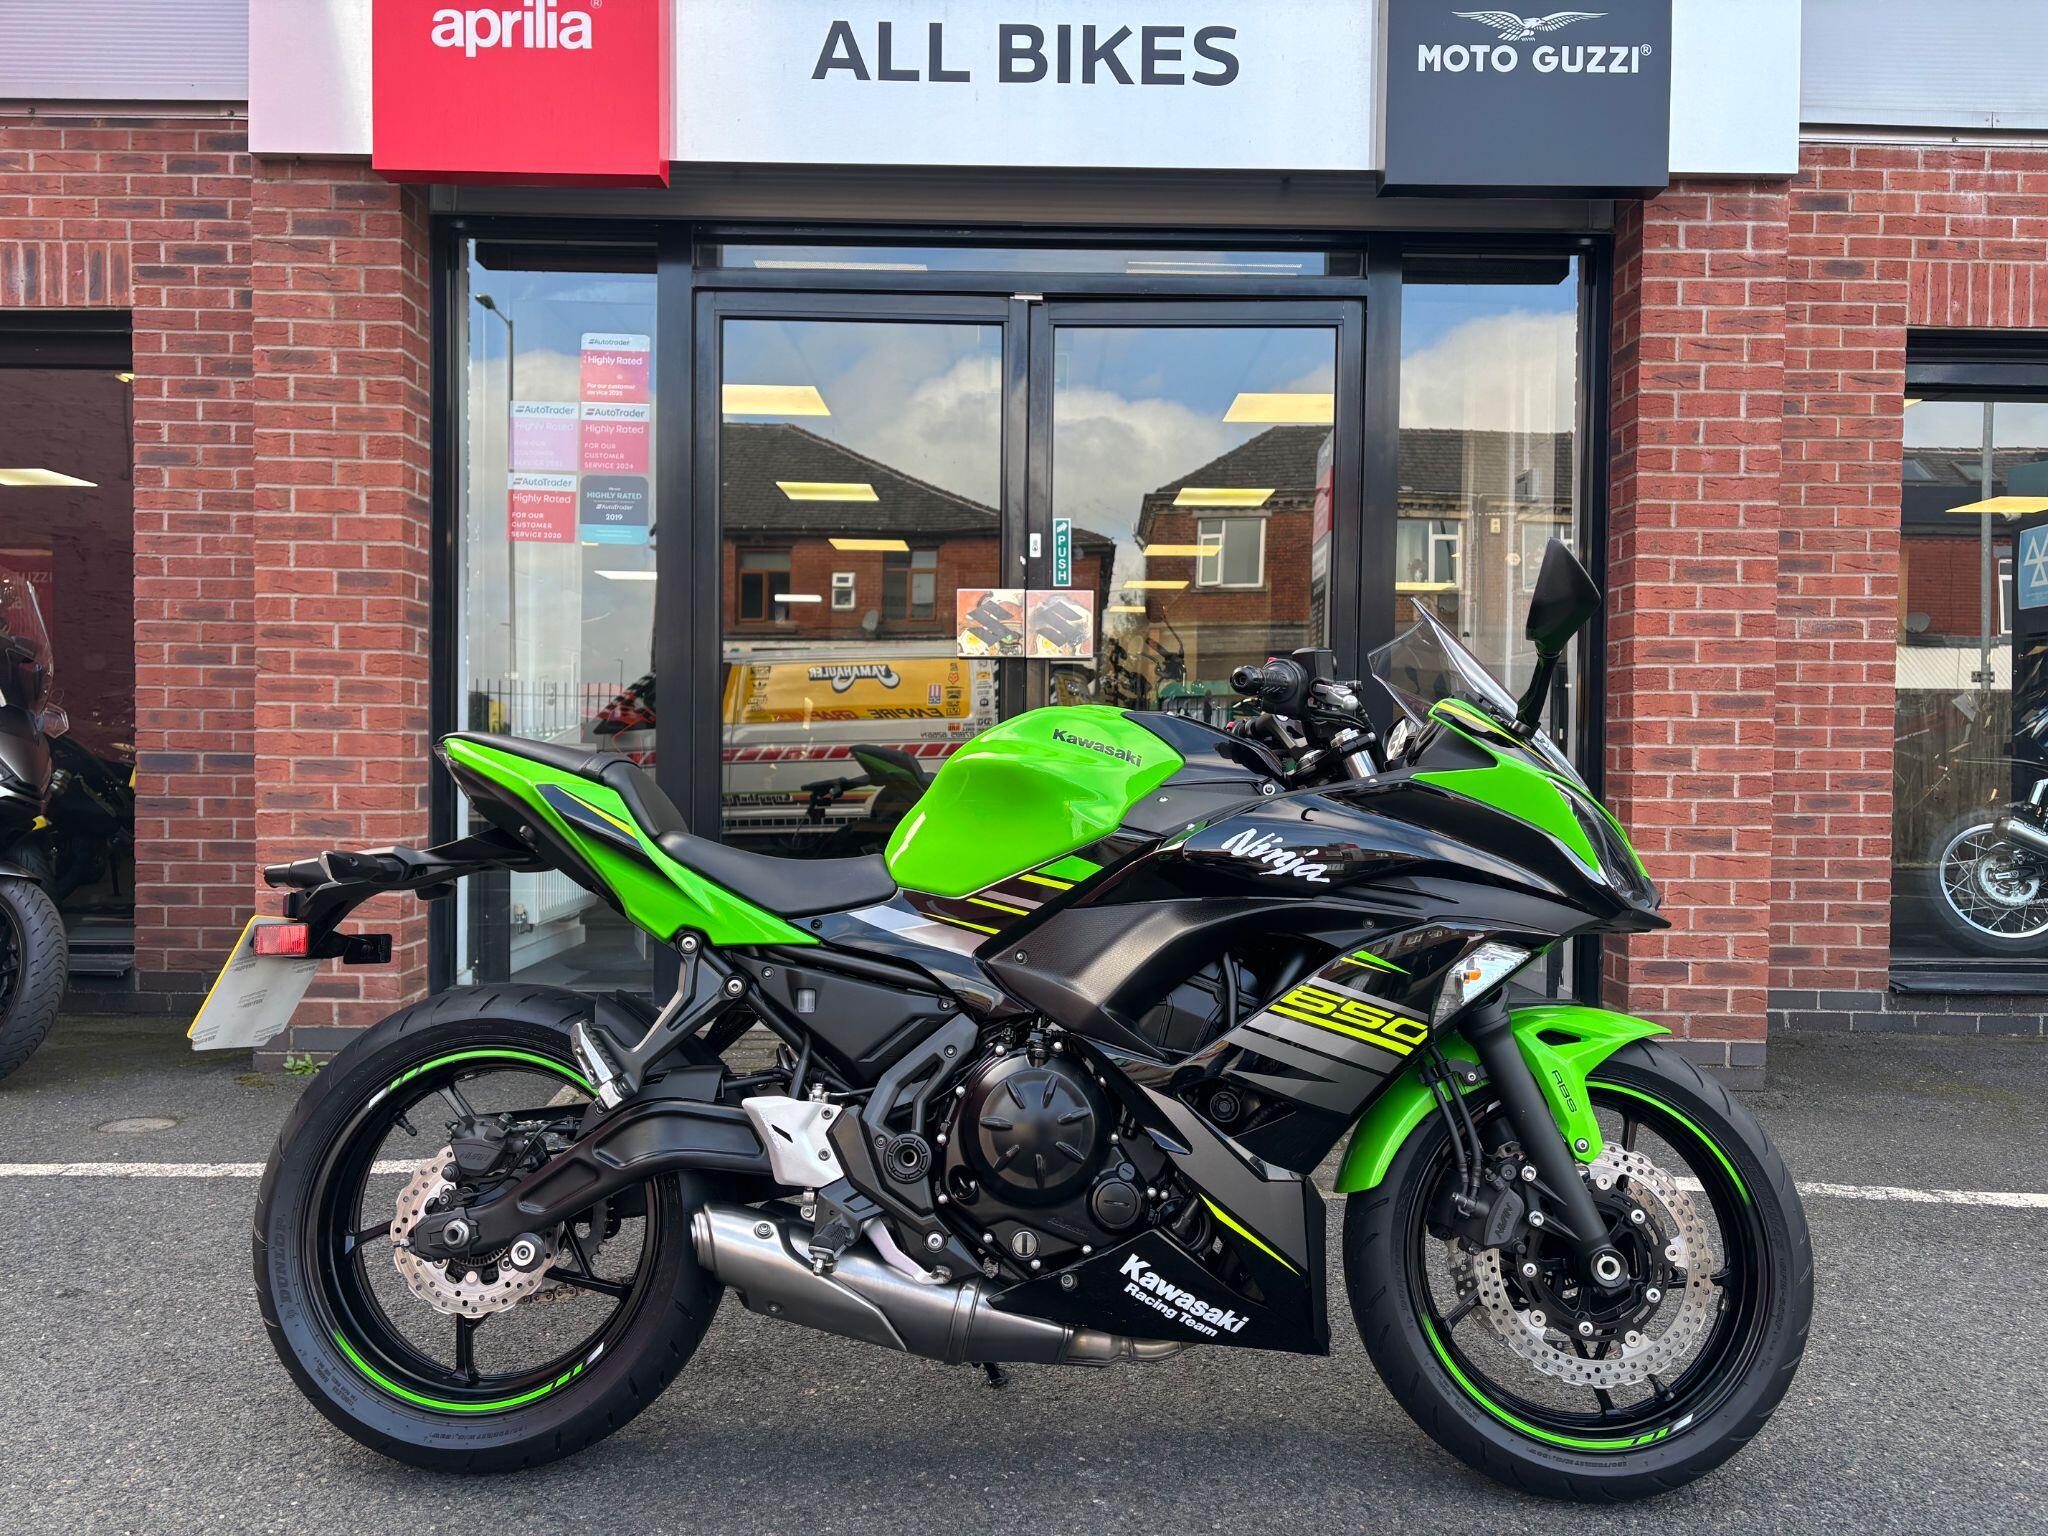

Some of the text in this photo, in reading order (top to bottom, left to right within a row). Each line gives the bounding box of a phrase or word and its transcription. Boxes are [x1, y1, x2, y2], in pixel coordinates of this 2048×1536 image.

[431, 0, 593, 57] aprilia
[811, 20, 1240, 87] ALL BIKES
[1416, 44, 1640, 75] MOTO GUZZI
[587, 354, 643, 366] Highly Rated
[524, 405, 575, 415] AutoTrader
[594, 408, 645, 418] AutoTrader
[585, 424, 644, 435] Highly Rated
[584, 452, 625, 460] CUSTOMER
[522, 477, 572, 487] AutoTrader
[512, 493, 571, 505] Highly Rated
[586, 491, 642, 500] HIGHLY RATED
[511, 511, 527, 519] FOR
[605, 513, 624, 521] 2019
[511, 521, 552, 529] CUSTOMER
[511, 530, 542, 538] SERVICE
[1057, 535, 1067, 581] PUSH
[1052, 728, 1142, 768] Kawasaki
[1220, 827, 1331, 884] Ninja
[1280, 985, 1429, 1045] 650
[1551, 1069, 1578, 1113] ABS
[1119, 1253, 1250, 1333] Kawasaki
[1123, 1282, 1218, 1337] Racing Team
